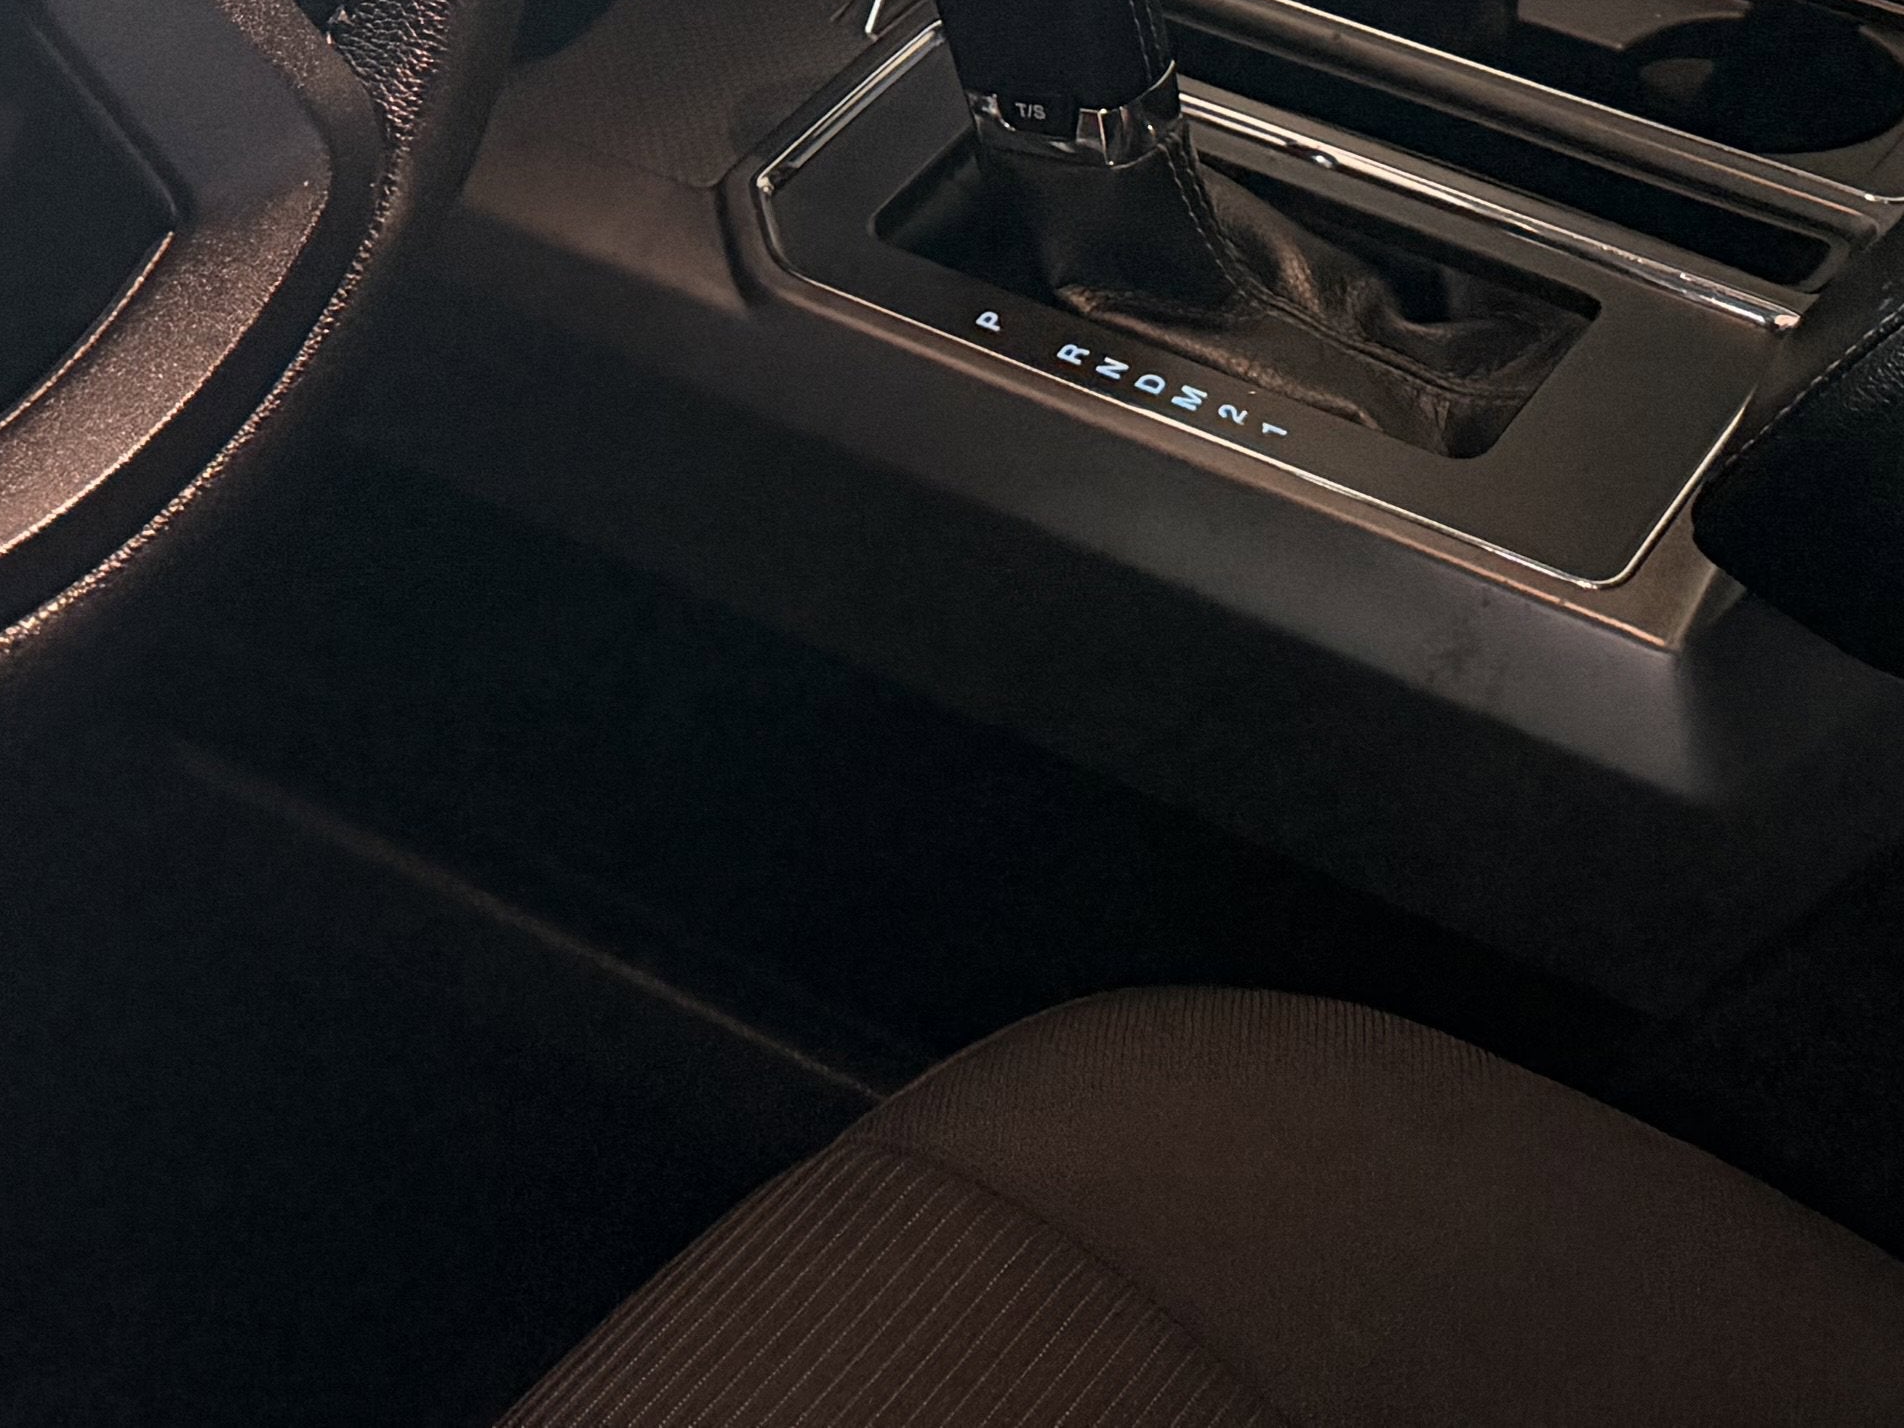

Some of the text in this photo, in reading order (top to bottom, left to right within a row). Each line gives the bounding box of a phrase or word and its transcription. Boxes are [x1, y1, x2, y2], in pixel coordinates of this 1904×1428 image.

[975, 311, 1288, 437] P R N D M 2 1
